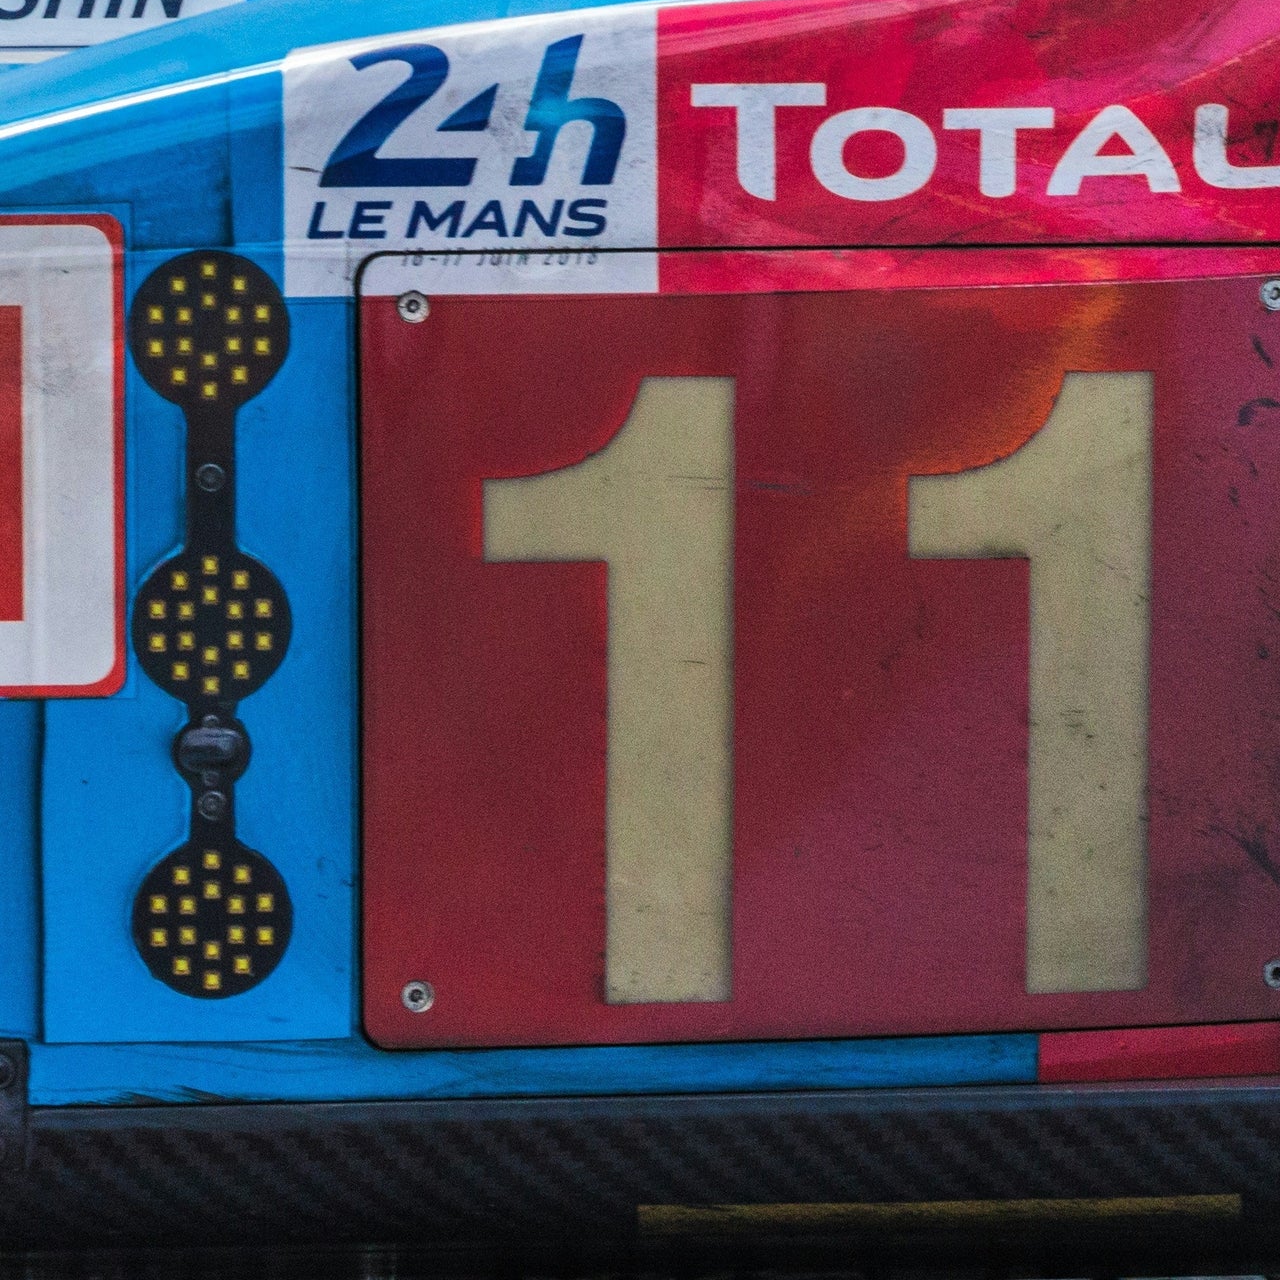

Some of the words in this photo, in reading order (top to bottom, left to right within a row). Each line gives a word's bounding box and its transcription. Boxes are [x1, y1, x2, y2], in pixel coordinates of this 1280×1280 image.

[319, 33, 628, 188] 24h
[306, 201, 386, 240] LE
[406, 198, 608, 240] MANS
[480, 370, 1155, 1006] 11
